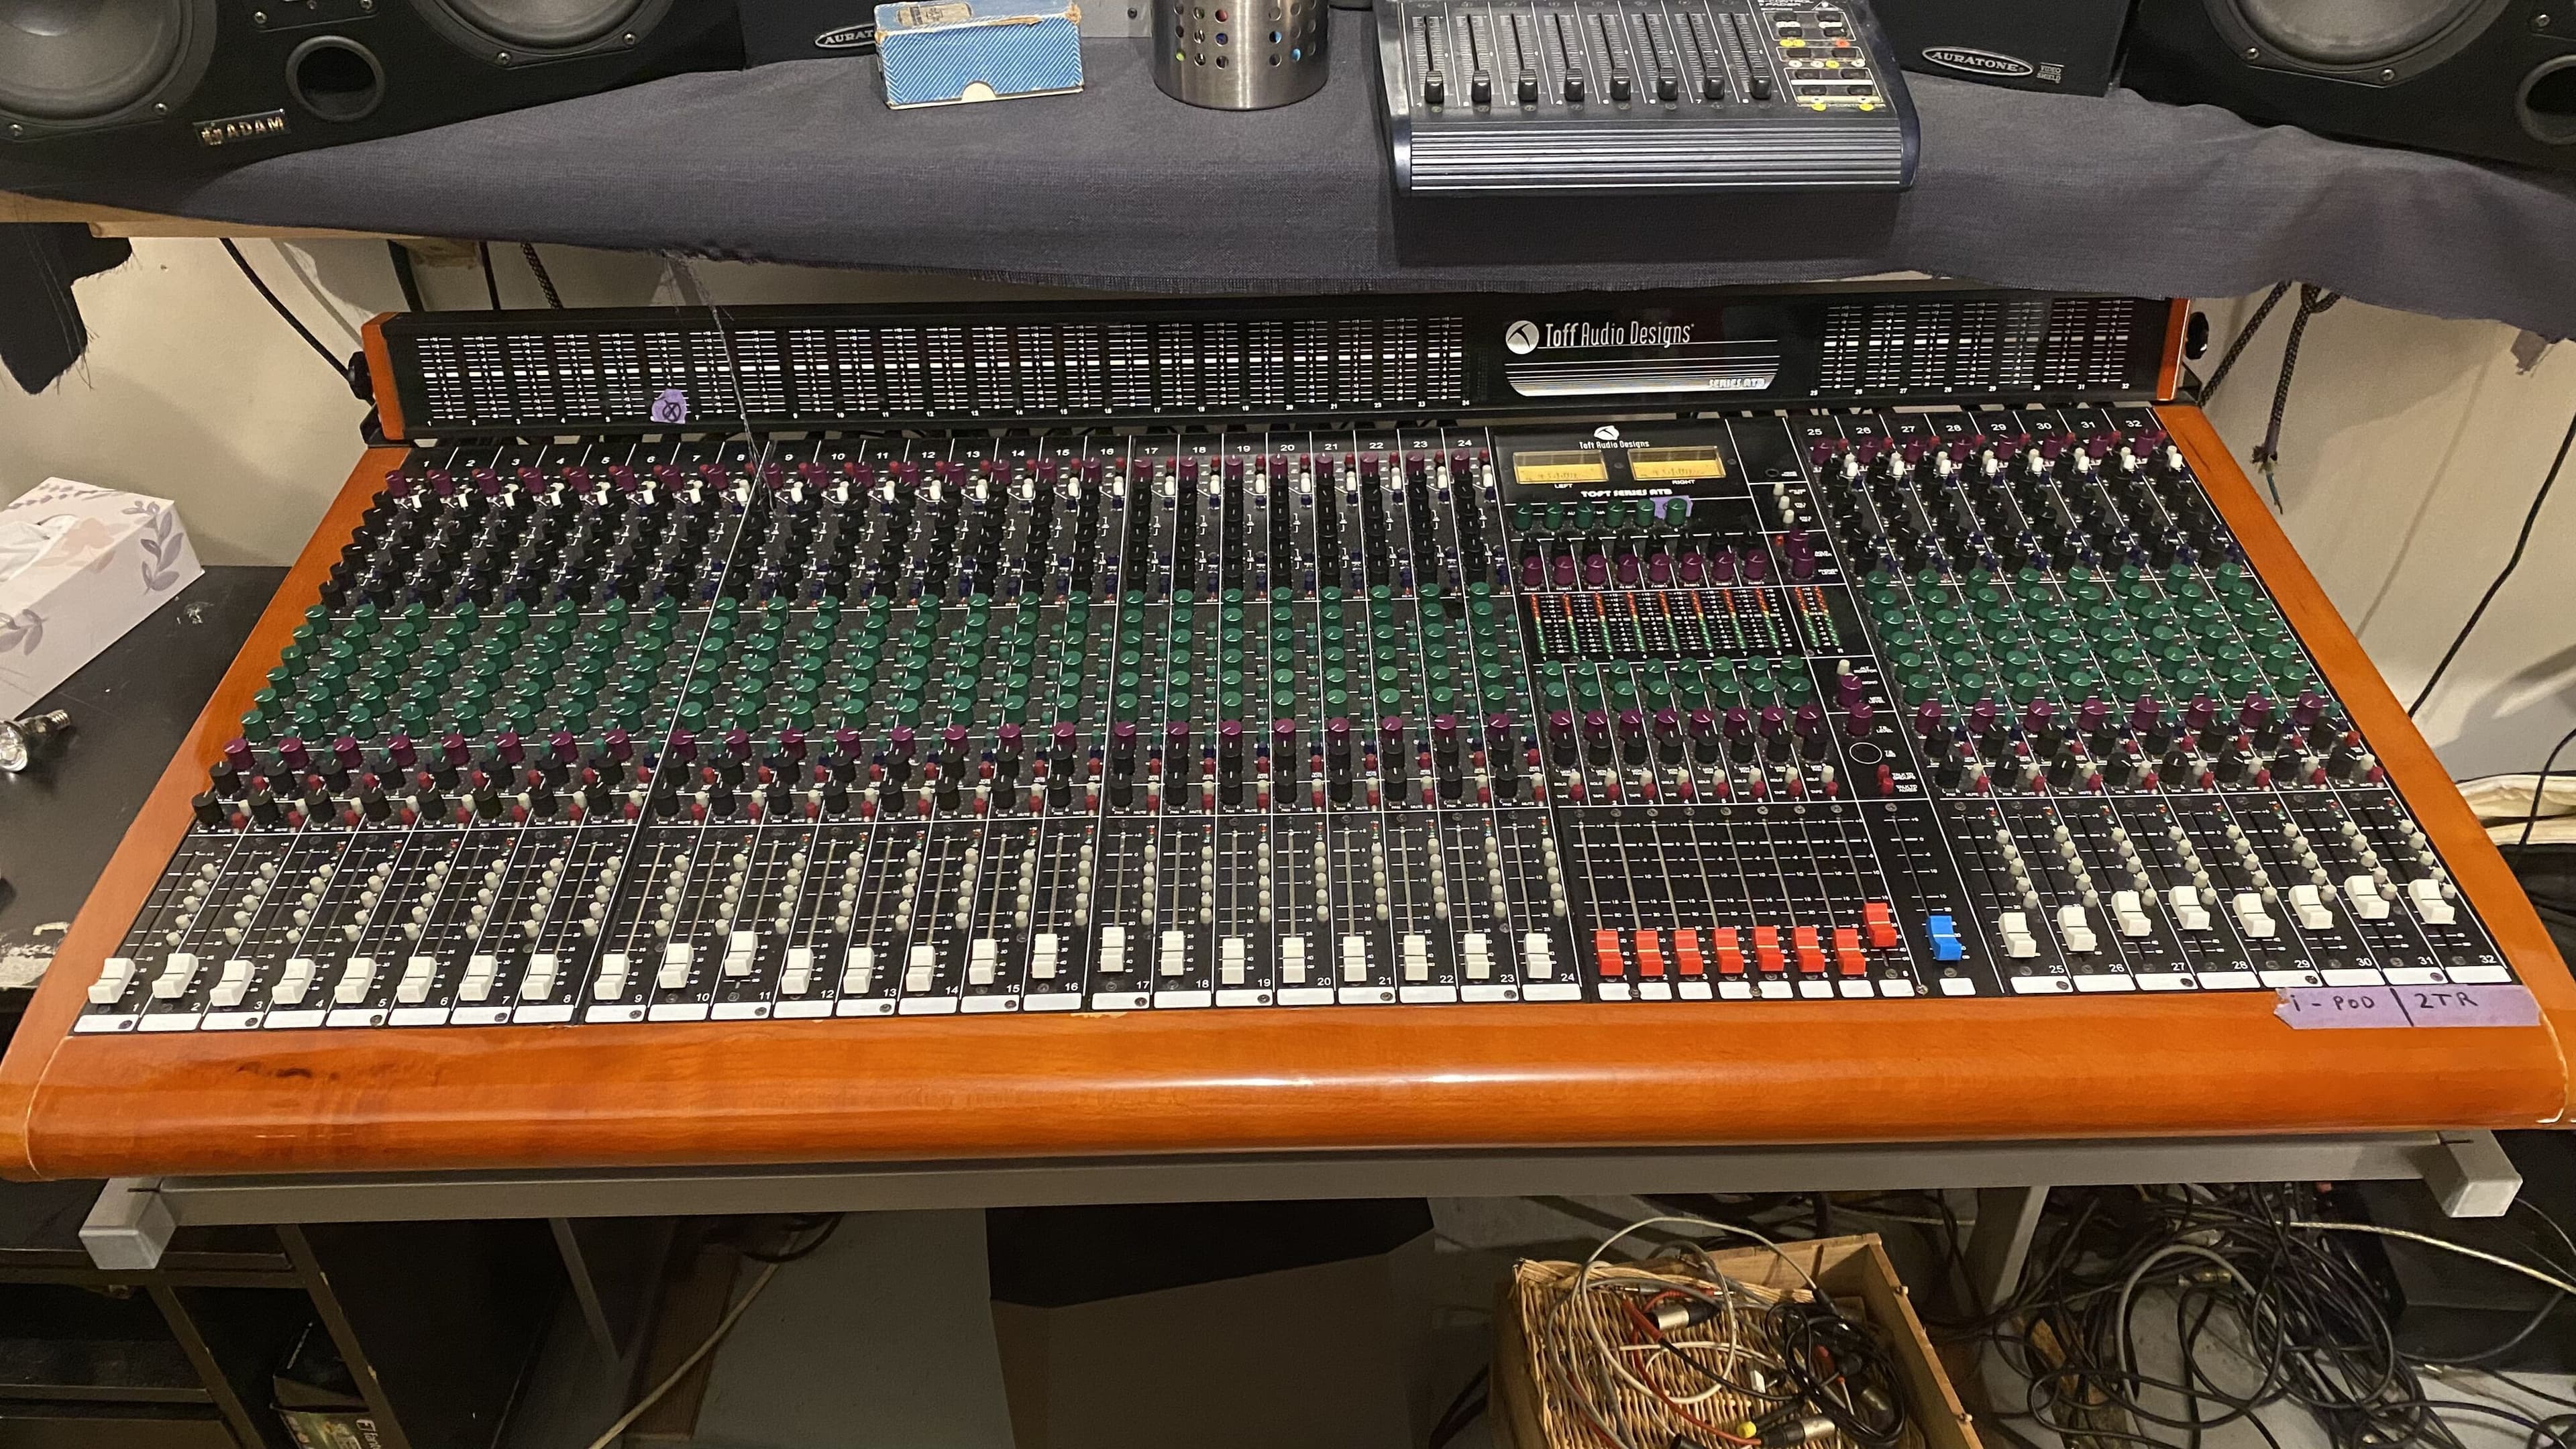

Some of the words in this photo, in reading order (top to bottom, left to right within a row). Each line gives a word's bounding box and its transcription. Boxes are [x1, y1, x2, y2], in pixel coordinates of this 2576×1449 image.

[1931, 51, 2019, 72] AURATONE
[2040, 65, 2061, 74] VIDEO
[2037, 72, 2061, 82] SHIELD
[226, 116, 284, 138] ADAM
[1580, 321, 1624, 347] Audio
[1630, 321, 1691, 349] Designs
[1945, 424, 1962, 432] 28
[1324, 443, 1338, 451] 21
[1369, 441, 1384, 449] 22
[1413, 440, 1428, 448] 23
[1596, 440, 1618, 449] Audio
[1619, 440, 1650, 449] Designs
[966, 450, 980, 458] 13
[1144, 447, 1159, 455] 17
[601, 456, 610, 464] 5
[737, 453, 745, 462] 8
[2294, 959, 2310, 969] 29
[2355, 957, 2373, 967] 30
[2417, 956, 2434, 965] 31
[2479, 955, 2498, 964] 32
[2049, 965, 2065, 974] 25
[2108, 963, 2125, 973] 26
[2171, 962, 2185, 971] 27
[2231, 961, 2249, 969] 28
[1317, 977, 1332, 986] 20
[1379, 976, 1391, 985] 21
[1440, 975, 1454, 983] 22
[1500, 974, 1515, 983] 23
[1560, 973, 1575, 982] 24
[1065, 982, 1079, 991] 16
[1136, 981, 1150, 990] 17
[1195, 979, 1210, 988] 18
[1257, 978, 1271, 987] 19
[883, 987, 897, 997] 13
[945, 985, 959, 995] 14
[1006, 984, 1020, 994] 15
[634, 994, 643, 1003] 9
[696, 992, 710, 1002] 10
[759, 991, 771, 1000] 11
[820, 989, 835, 999] 12
[315, 999, 324, 1008] 4
[378, 998, 387, 1008] 5
[440, 996, 449, 1006] 6
[502, 996, 511, 1004] 7
[563, 994, 572, 1004] 8
[2414, 991, 2479, 1008] 2TR
[133, 1003, 138, 1012] 1
[191, 1002, 201, 1012] 2
[254, 1001, 264, 1010] 3
